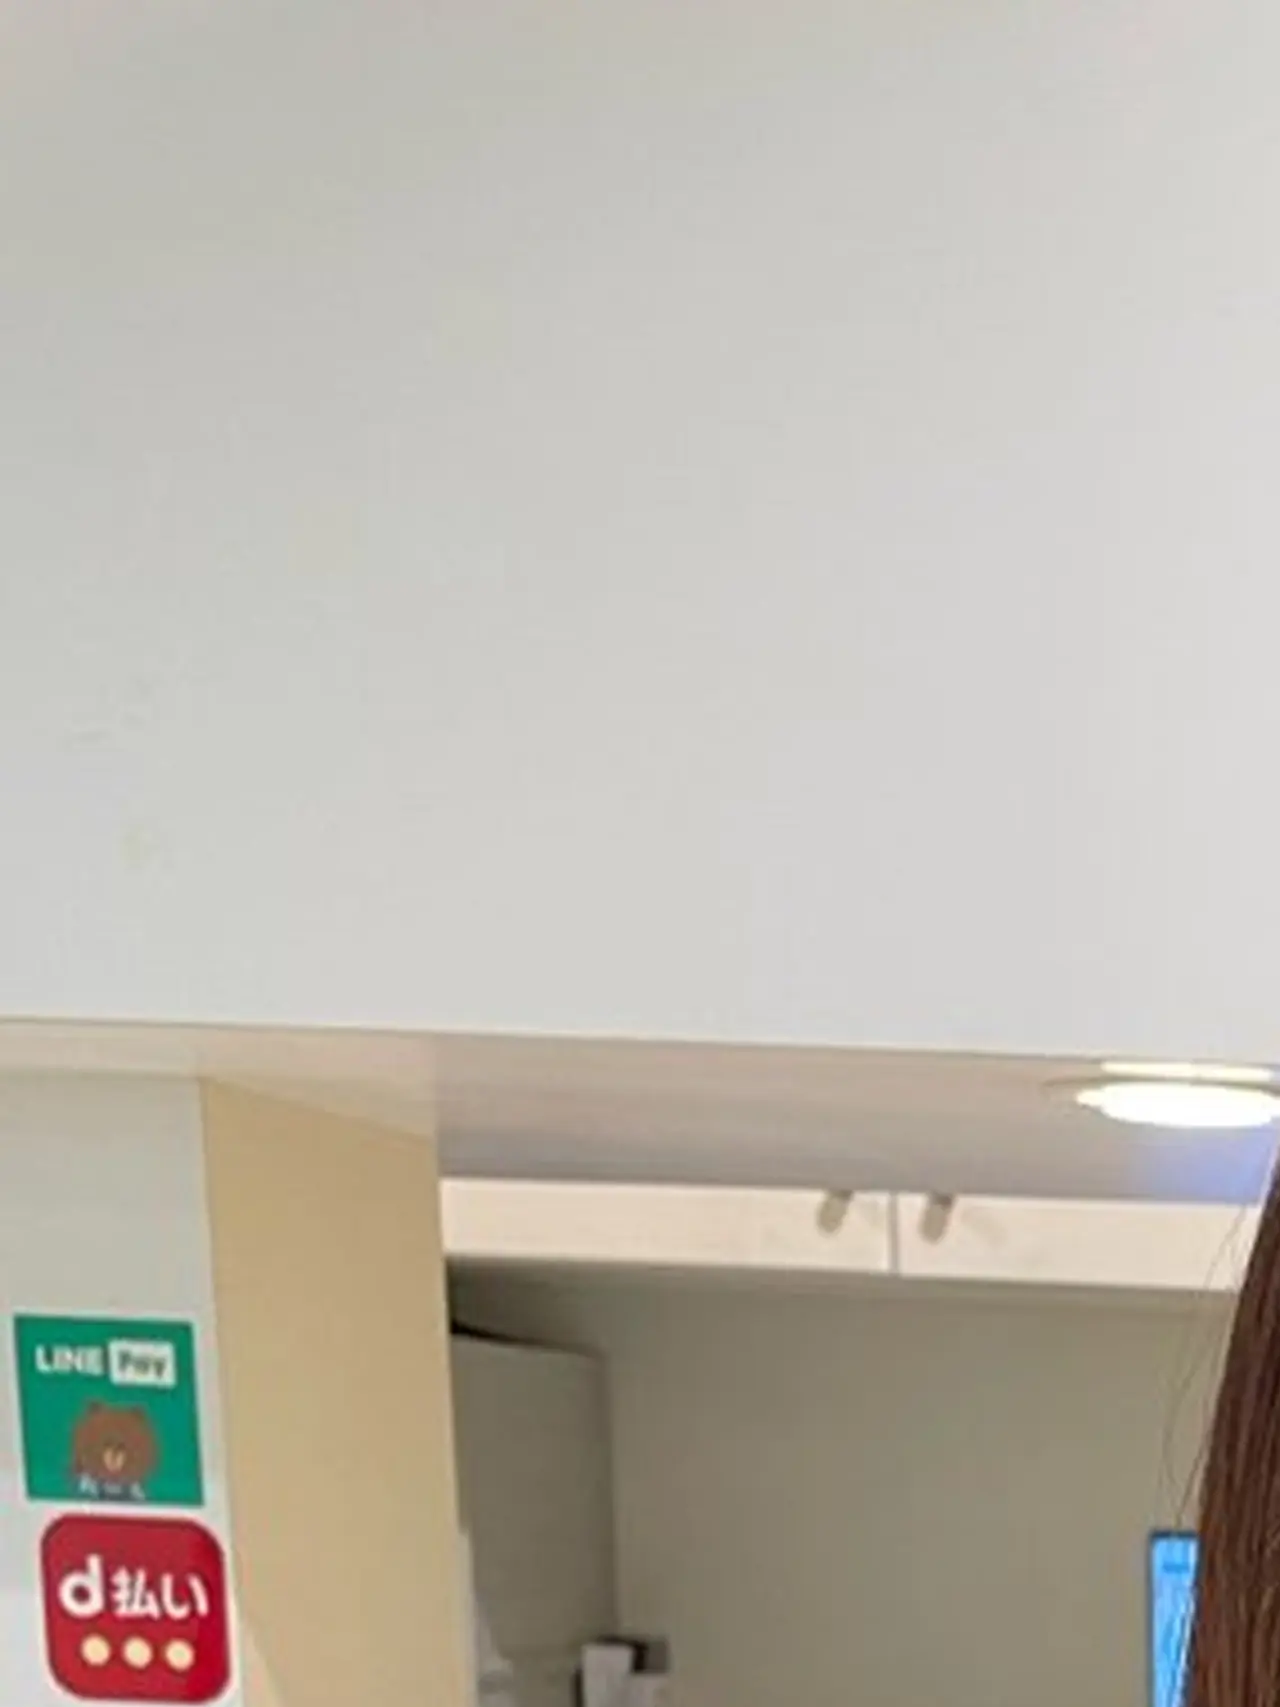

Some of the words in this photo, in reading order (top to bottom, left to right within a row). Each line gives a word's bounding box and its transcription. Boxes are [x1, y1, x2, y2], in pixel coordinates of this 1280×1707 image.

[35, 1345, 104, 1376] LINE
[118, 1350, 168, 1380] Pay
[57, 1553, 211, 1620] d払い
